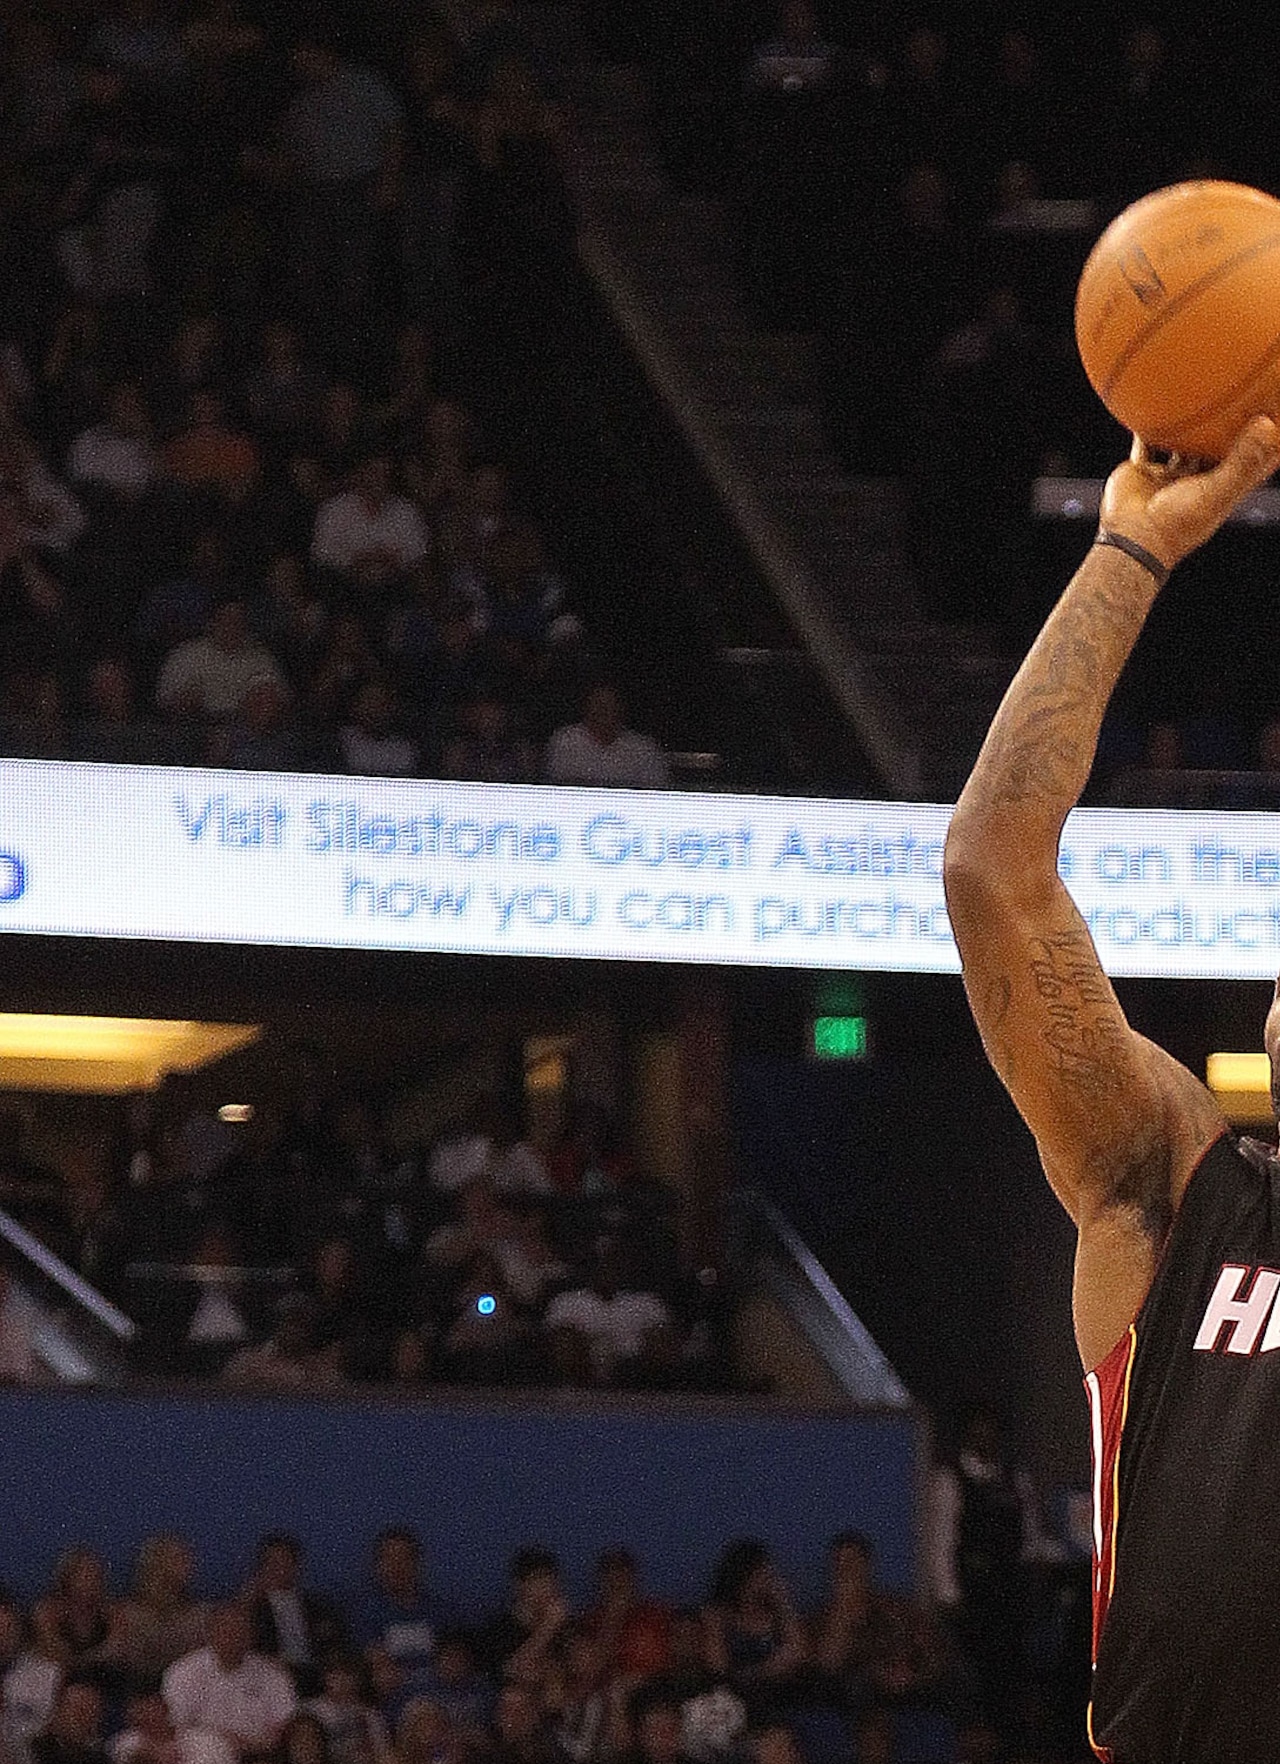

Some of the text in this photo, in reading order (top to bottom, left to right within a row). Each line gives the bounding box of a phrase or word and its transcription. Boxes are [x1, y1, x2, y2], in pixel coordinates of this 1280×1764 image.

[173, 796, 287, 848] Visit
[304, 800, 562, 863] Silestone
[581, 812, 753, 870] Guest
[1093, 843, 1168, 886] on
[345, 866, 472, 918] how
[490, 883, 598, 934] you
[617, 889, 732, 932] can
